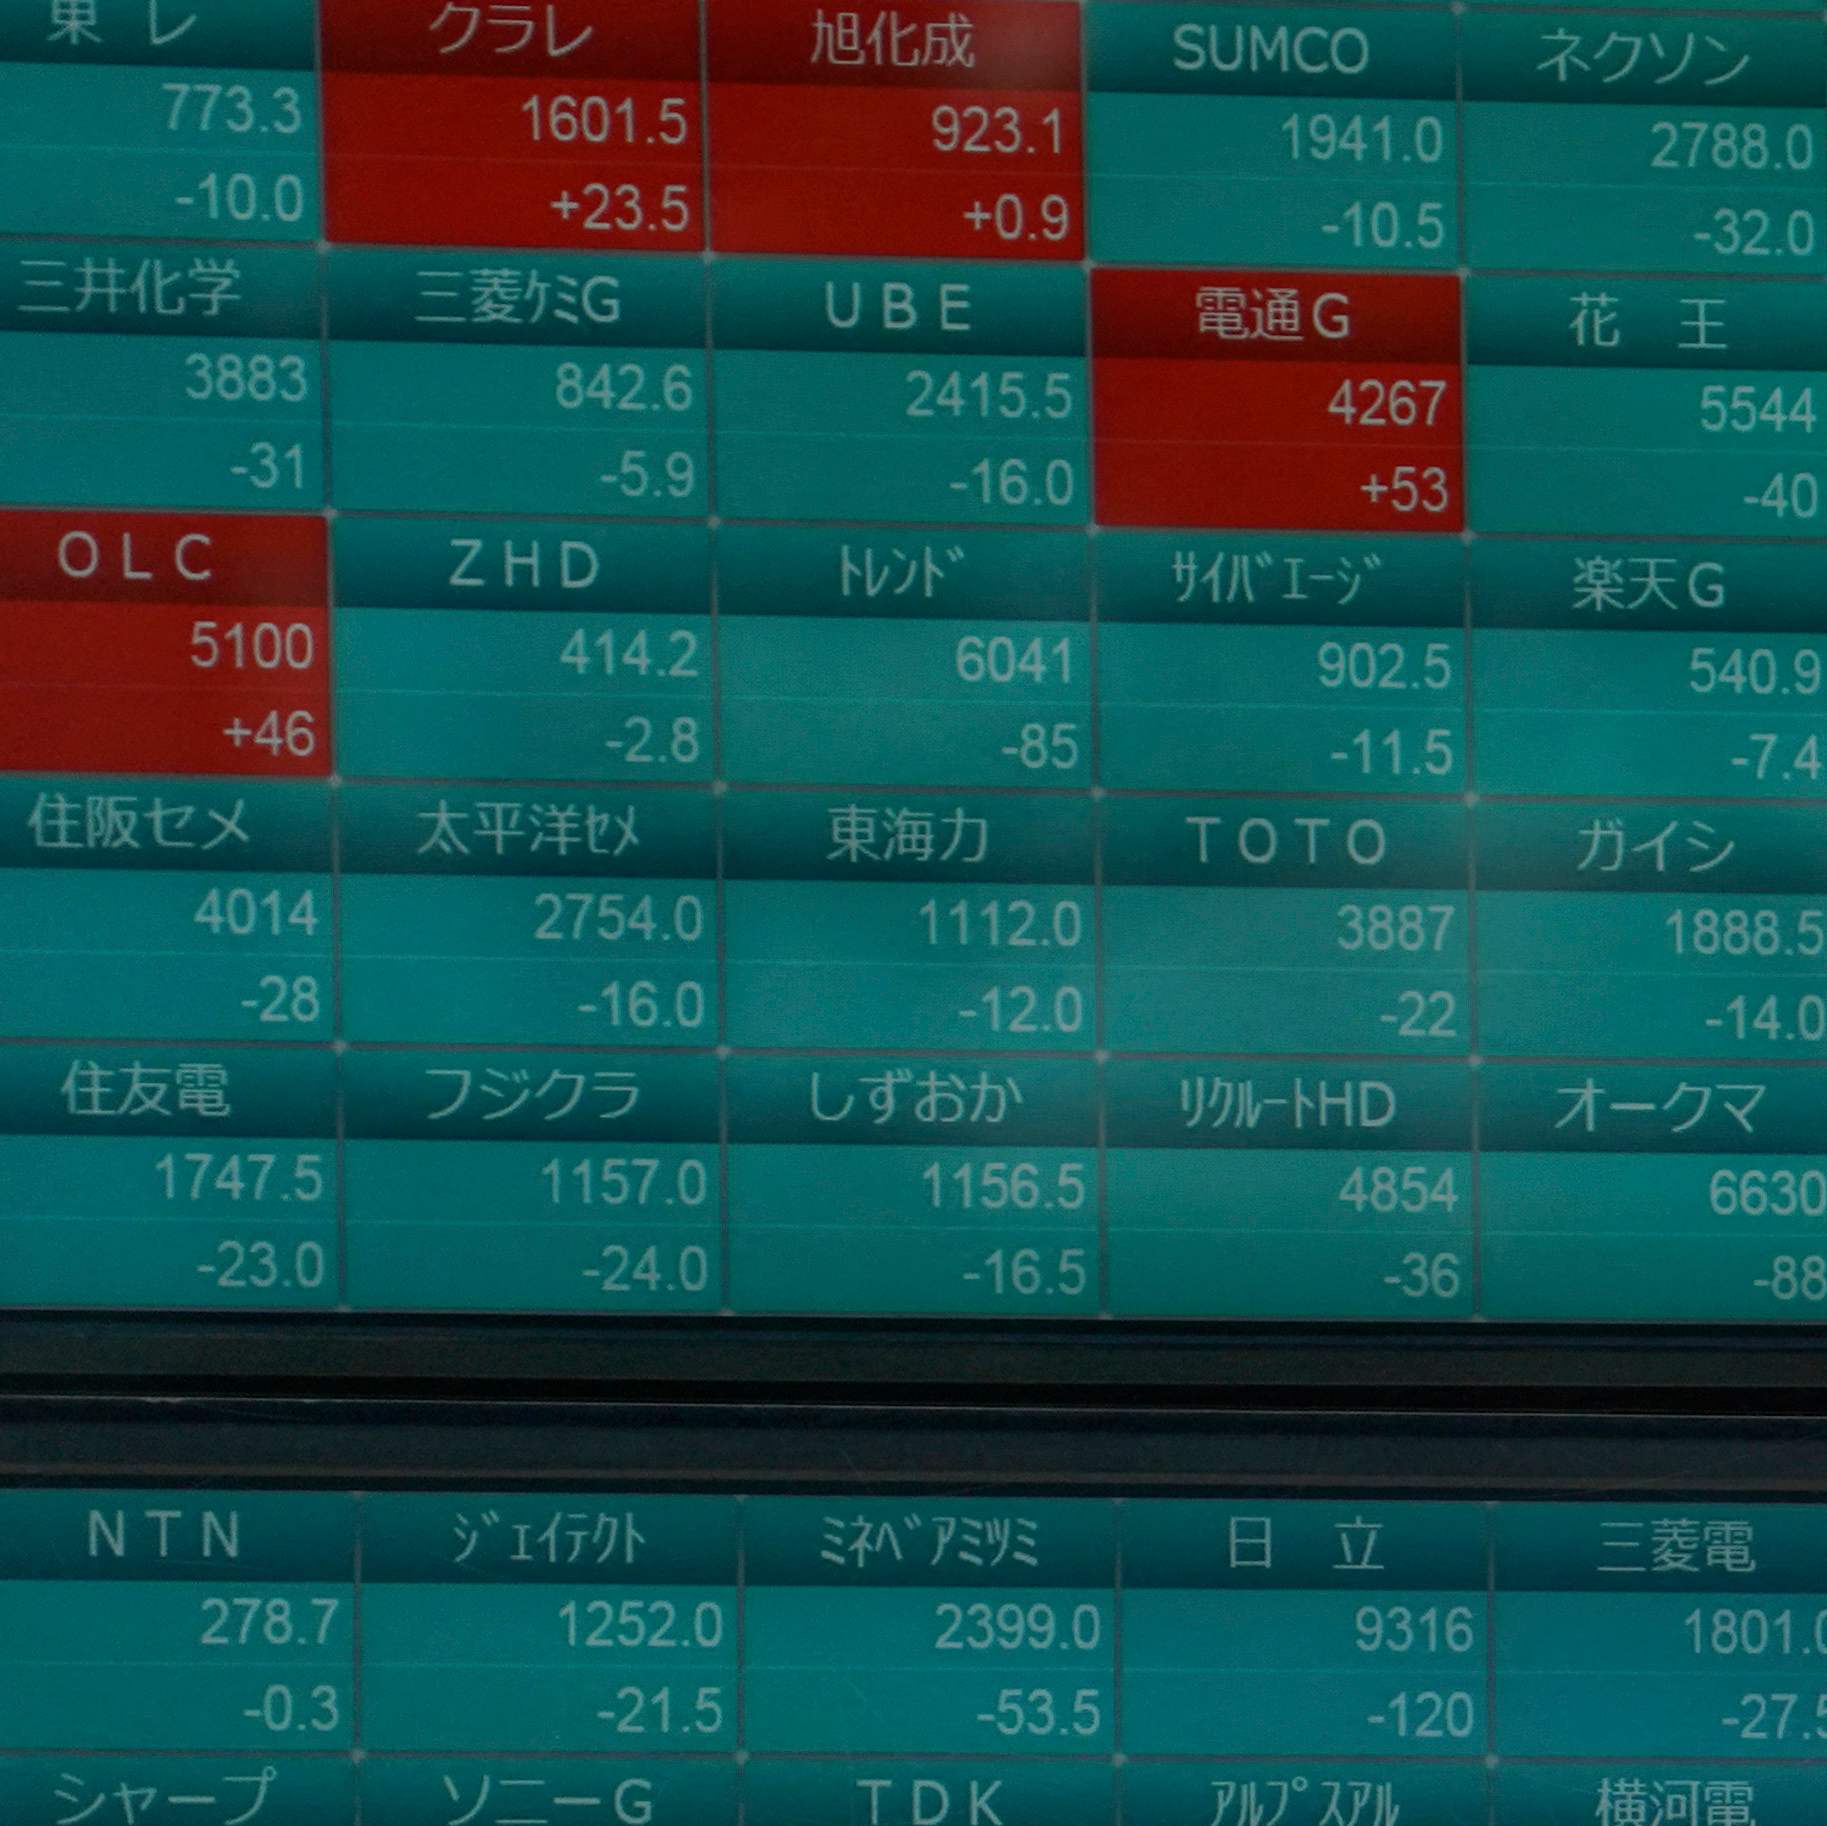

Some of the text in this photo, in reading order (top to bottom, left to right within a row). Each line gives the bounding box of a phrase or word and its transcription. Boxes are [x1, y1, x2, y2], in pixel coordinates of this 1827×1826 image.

[429, 0, 594, 58] クラレ
[810, 8, 976, 68] 旭化成
[1173, 23, 1369, 74] SUMCO
[1538, 28, 1749, 85] ネクソン
[522, 93, 689, 146] 1601.5
[932, 104, 1062, 155] 923.1
[550, 182, 691, 233] +23.5
[963, 192, 1071, 242] +0.9
[19, 258, 240, 316] 三井化学
[1195, 287, 1351, 341] 電通G
[1327, 378, 1448, 427] 4267
[231, 441, 302, 489] -31
[1360, 465, 1450, 513] +53
[1573, 556, 1724, 611] 楽天G
[191, 620, 315, 671] 5100
[560, 628, 699, 677] 414.2
[223, 709, 317, 758] +46
[27, 793, 249, 850] 住阪セメ
[920, 899, 1081, 947] 1112.0
[61, 1060, 231, 1117] 住友電
[427, 1068, 638, 1120] フジクラ
[811, 1068, 1022, 1125] しずおか
[542, 1158, 706, 1206] 1157.0
[923, 1161, 1085, 1210] 1156.5
[1598, 1518, 1756, 1573] 三菱電
[559, 1600, 723, 1648] 1252.0
[55, 1766, 277, 1826] シャープ
[443, 1775, 652, 1826] ソニーG
